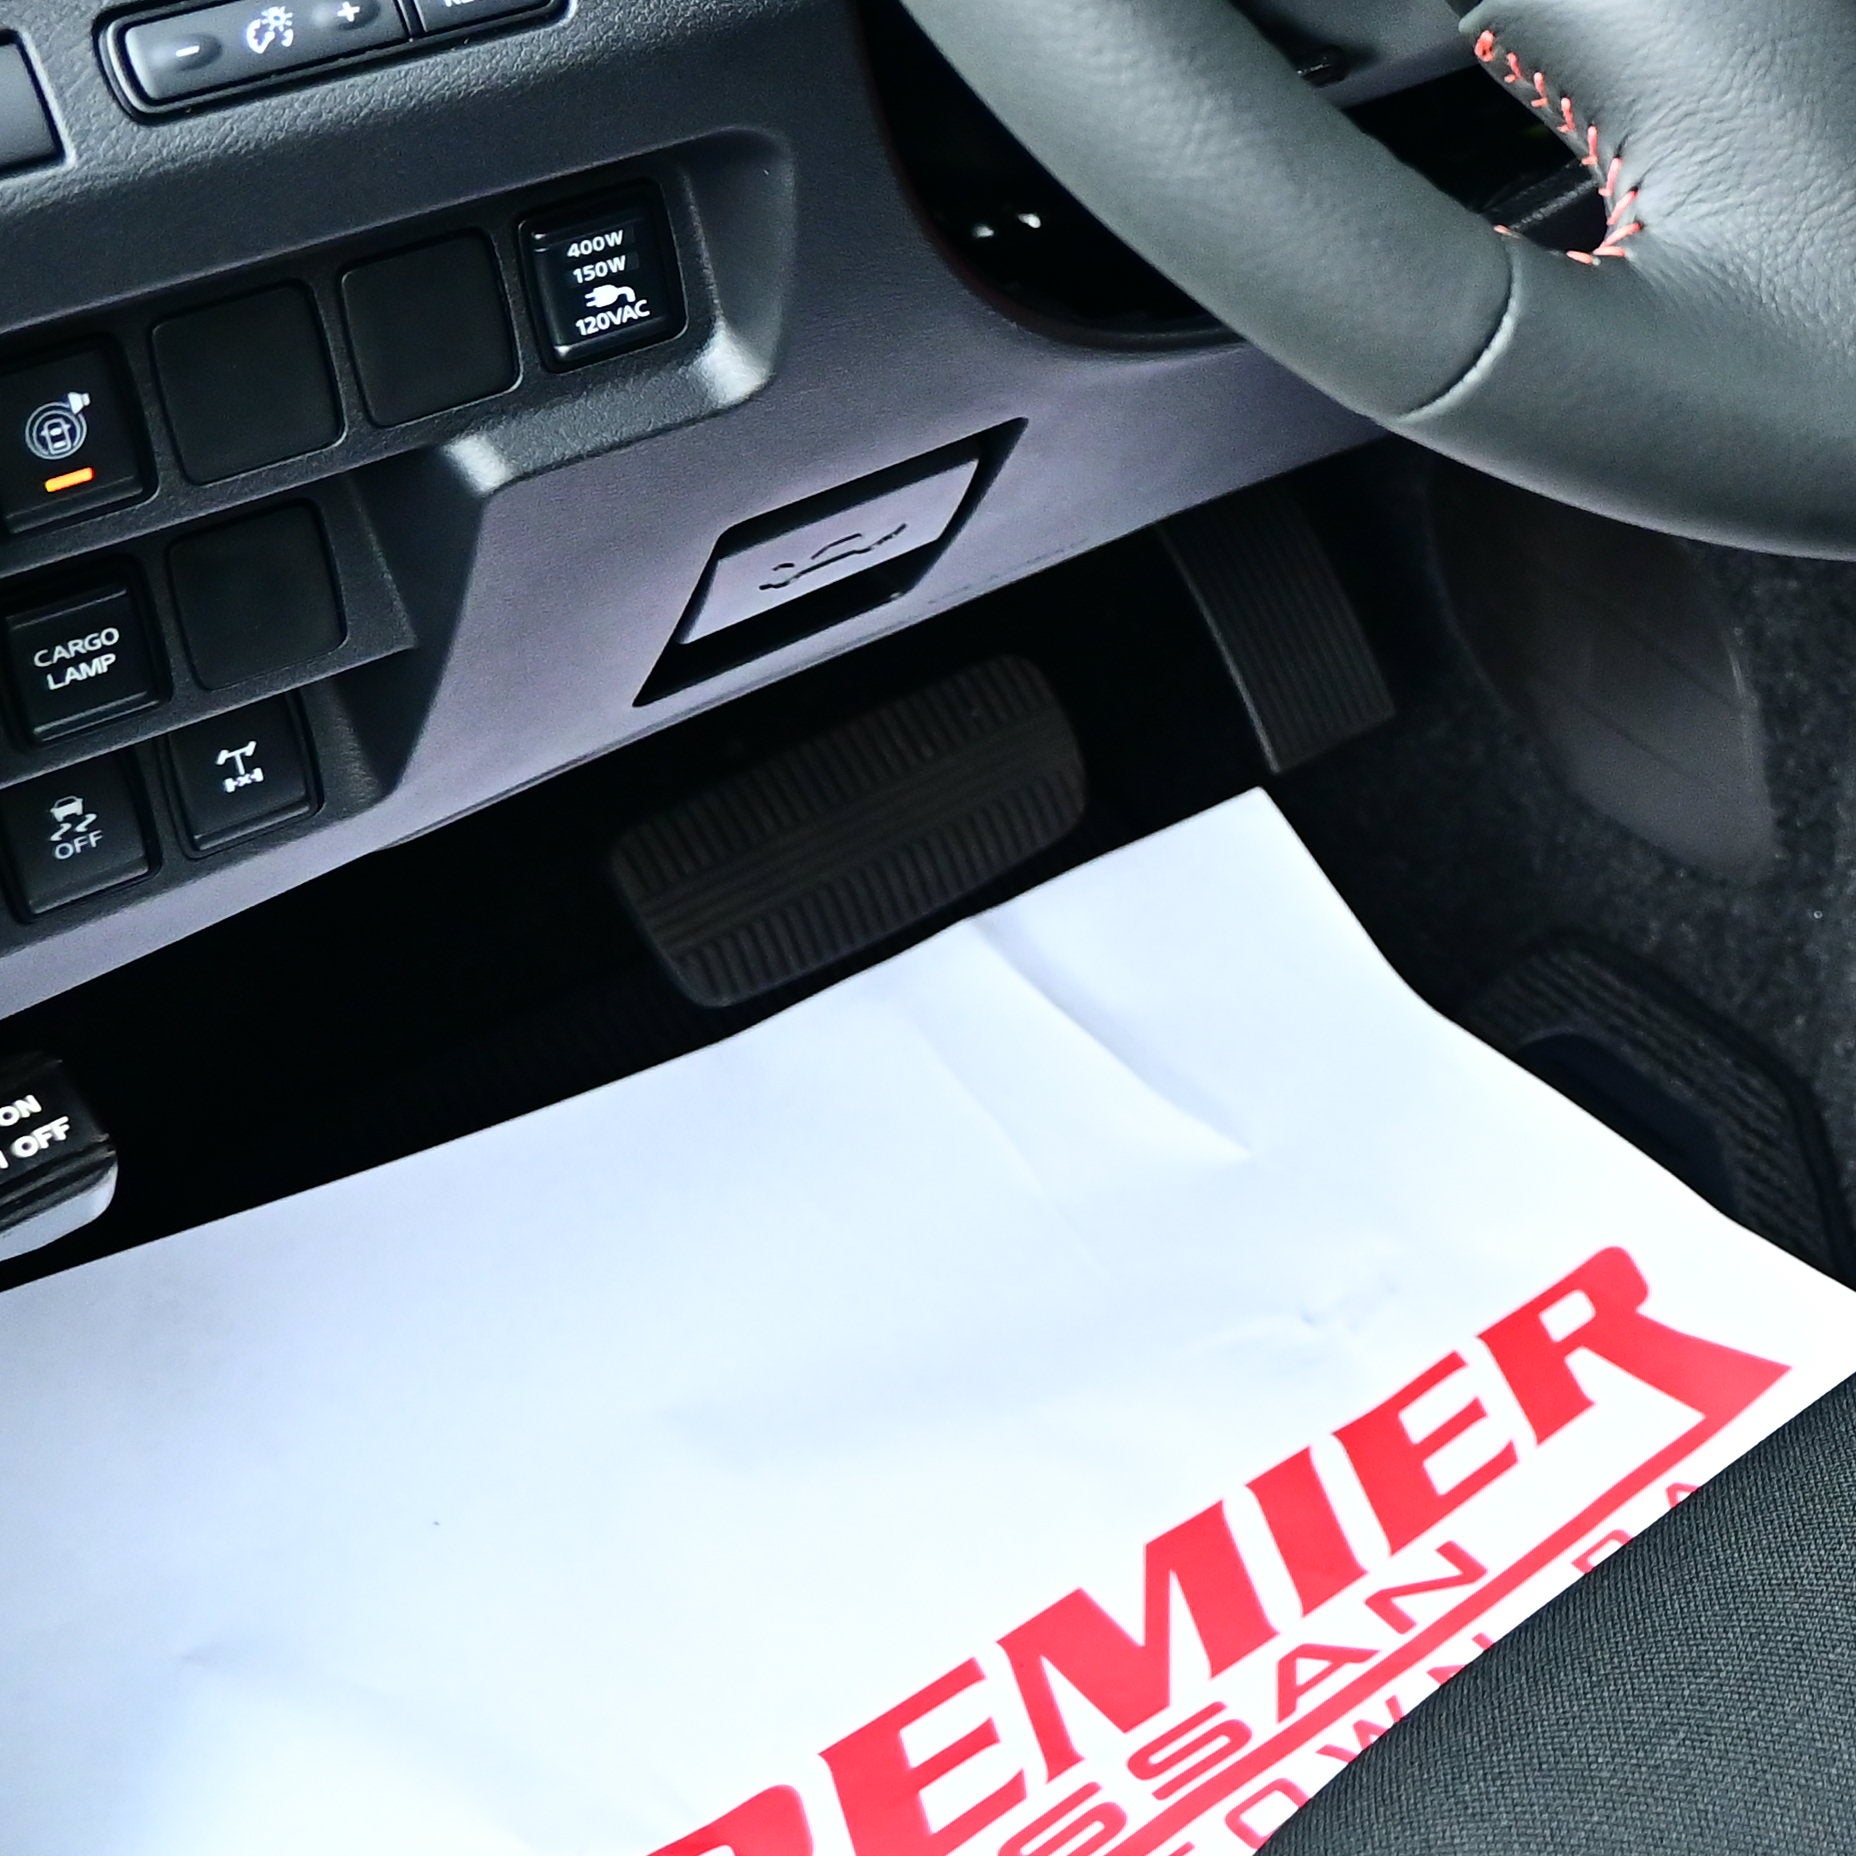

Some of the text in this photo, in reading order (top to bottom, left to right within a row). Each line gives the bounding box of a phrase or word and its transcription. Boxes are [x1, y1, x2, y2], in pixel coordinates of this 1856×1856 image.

[566, 229, 626, 259] 400W
[572, 254, 628, 284] 150W
[574, 298, 652, 338] 120VAC
[33, 627, 121, 667] CARGO
[46, 652, 117, 691] LAMP
[53, 827, 104, 861] OFF
[0, 1094, 42, 1127] ON
[10, 1115, 70, 1159] OFF
